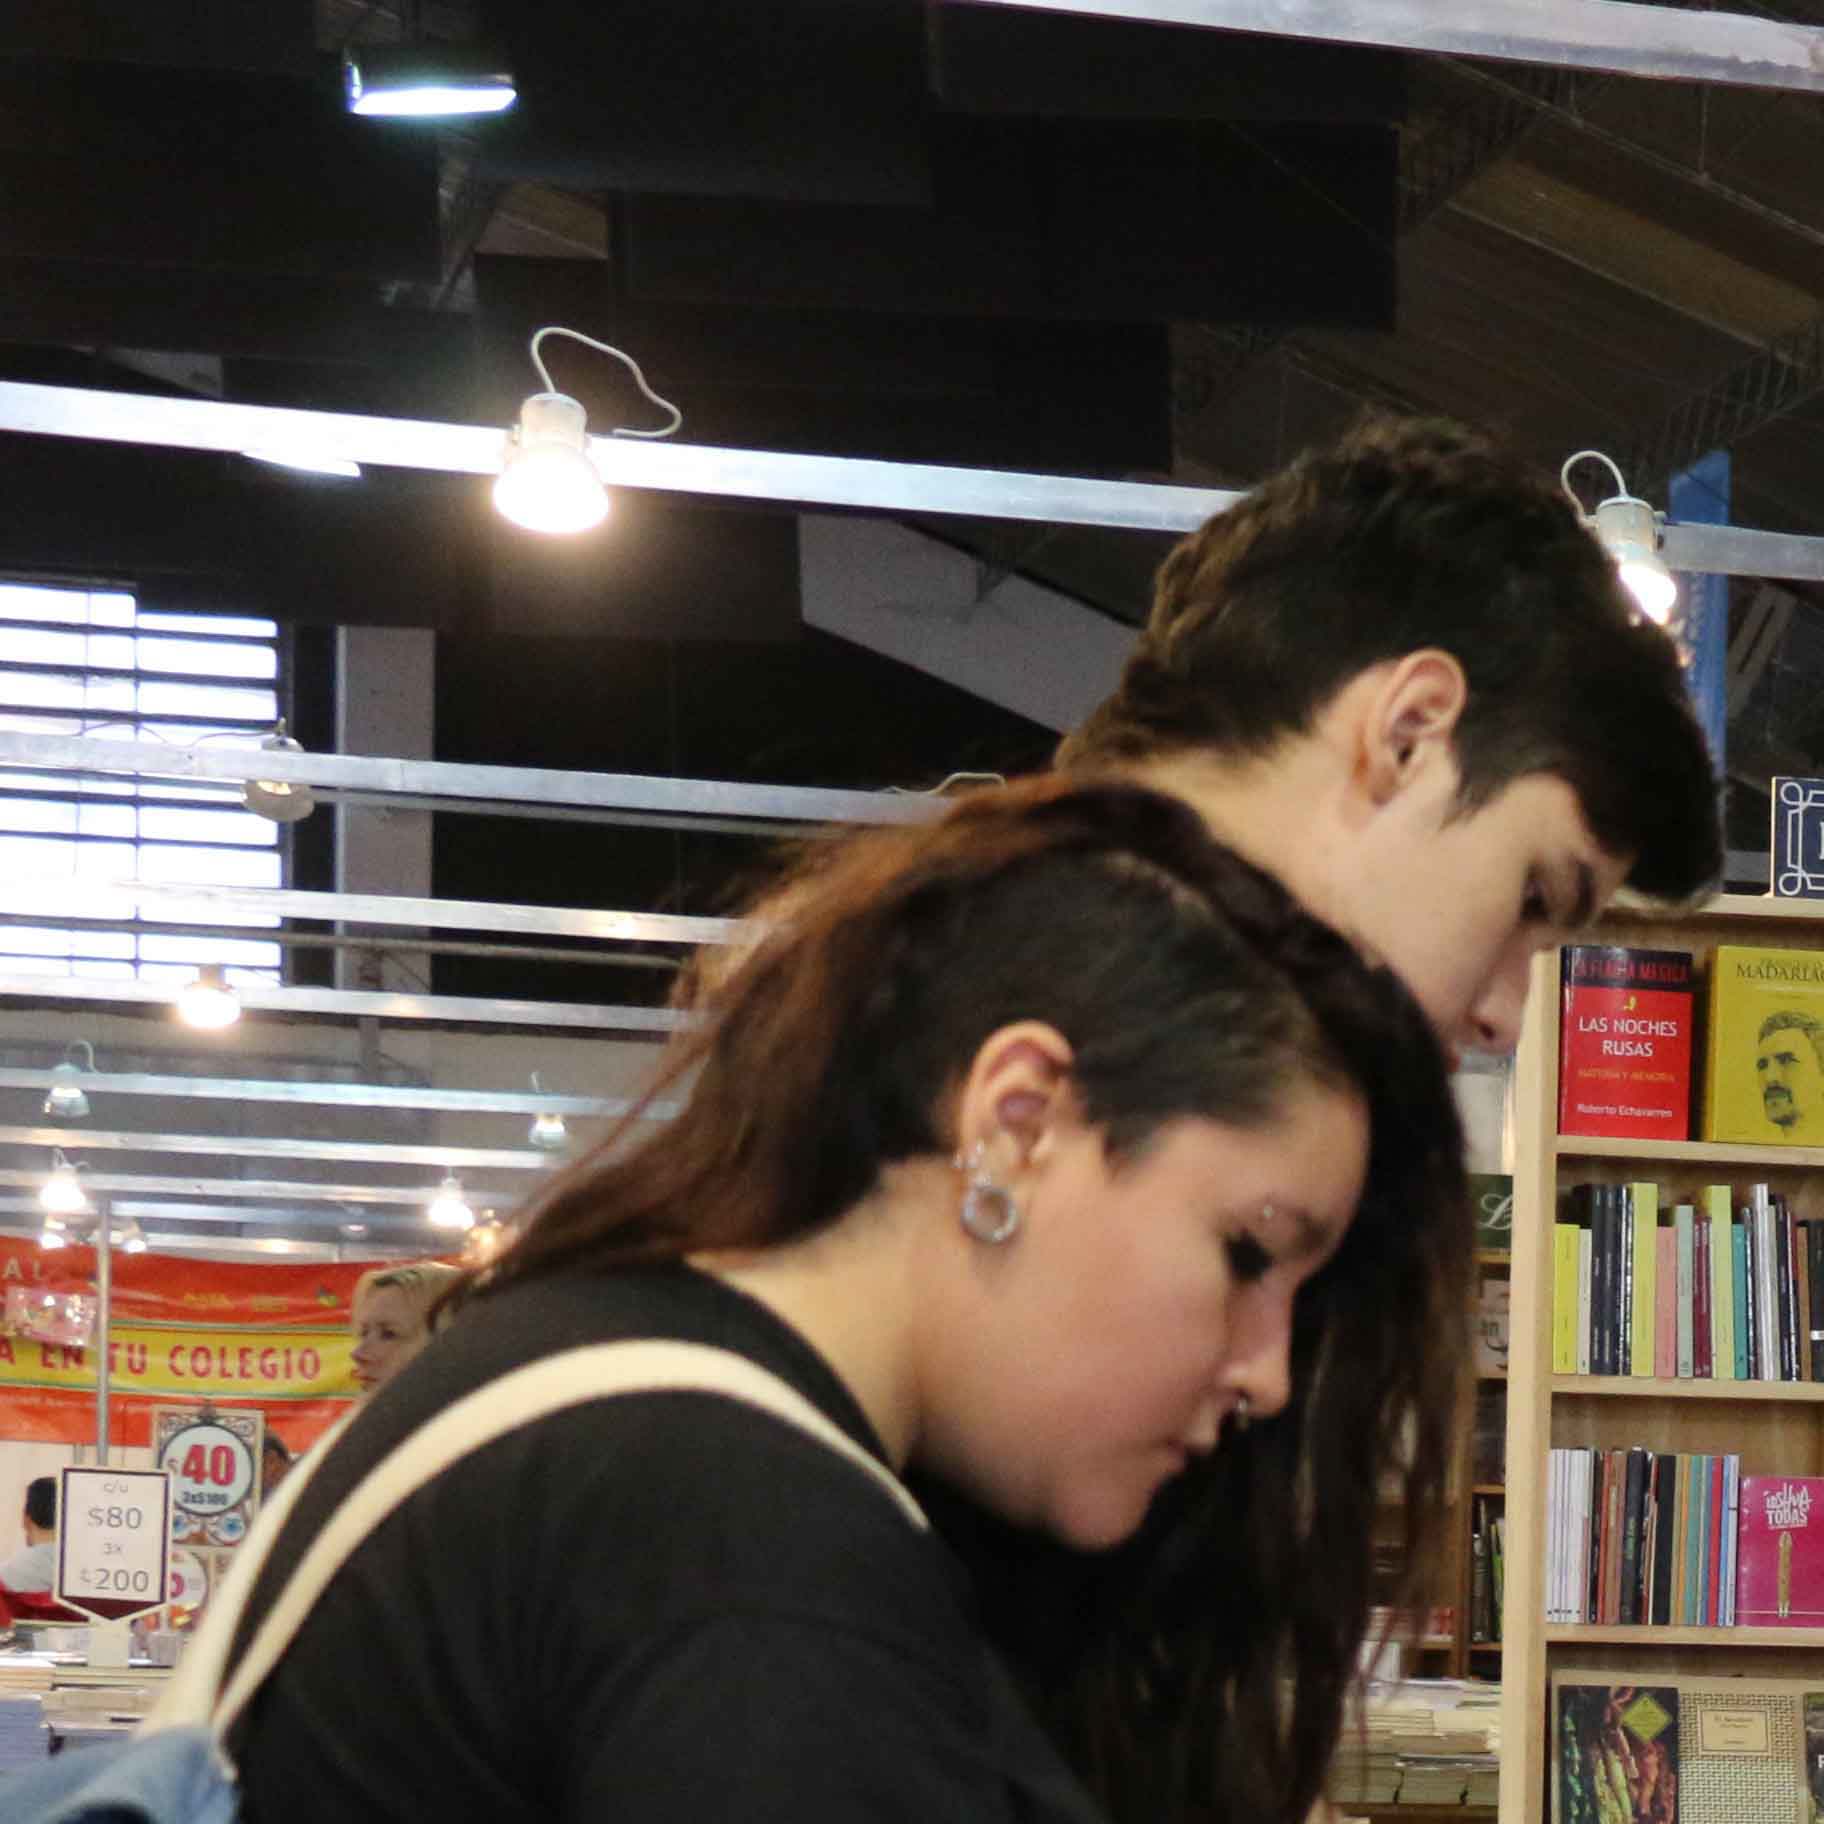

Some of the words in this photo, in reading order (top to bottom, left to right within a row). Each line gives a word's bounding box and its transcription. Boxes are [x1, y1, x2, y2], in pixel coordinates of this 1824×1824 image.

[1578, 1017, 1608, 1033] LAS
[1613, 1018, 1678, 1038] NOCHES
[1602, 1040, 1654, 1057] RUSAS
[1576, 1103, 1617, 1115] Roberto
[106, 1343, 148, 1375] TU
[168, 1345, 322, 1381] COLEGIO
